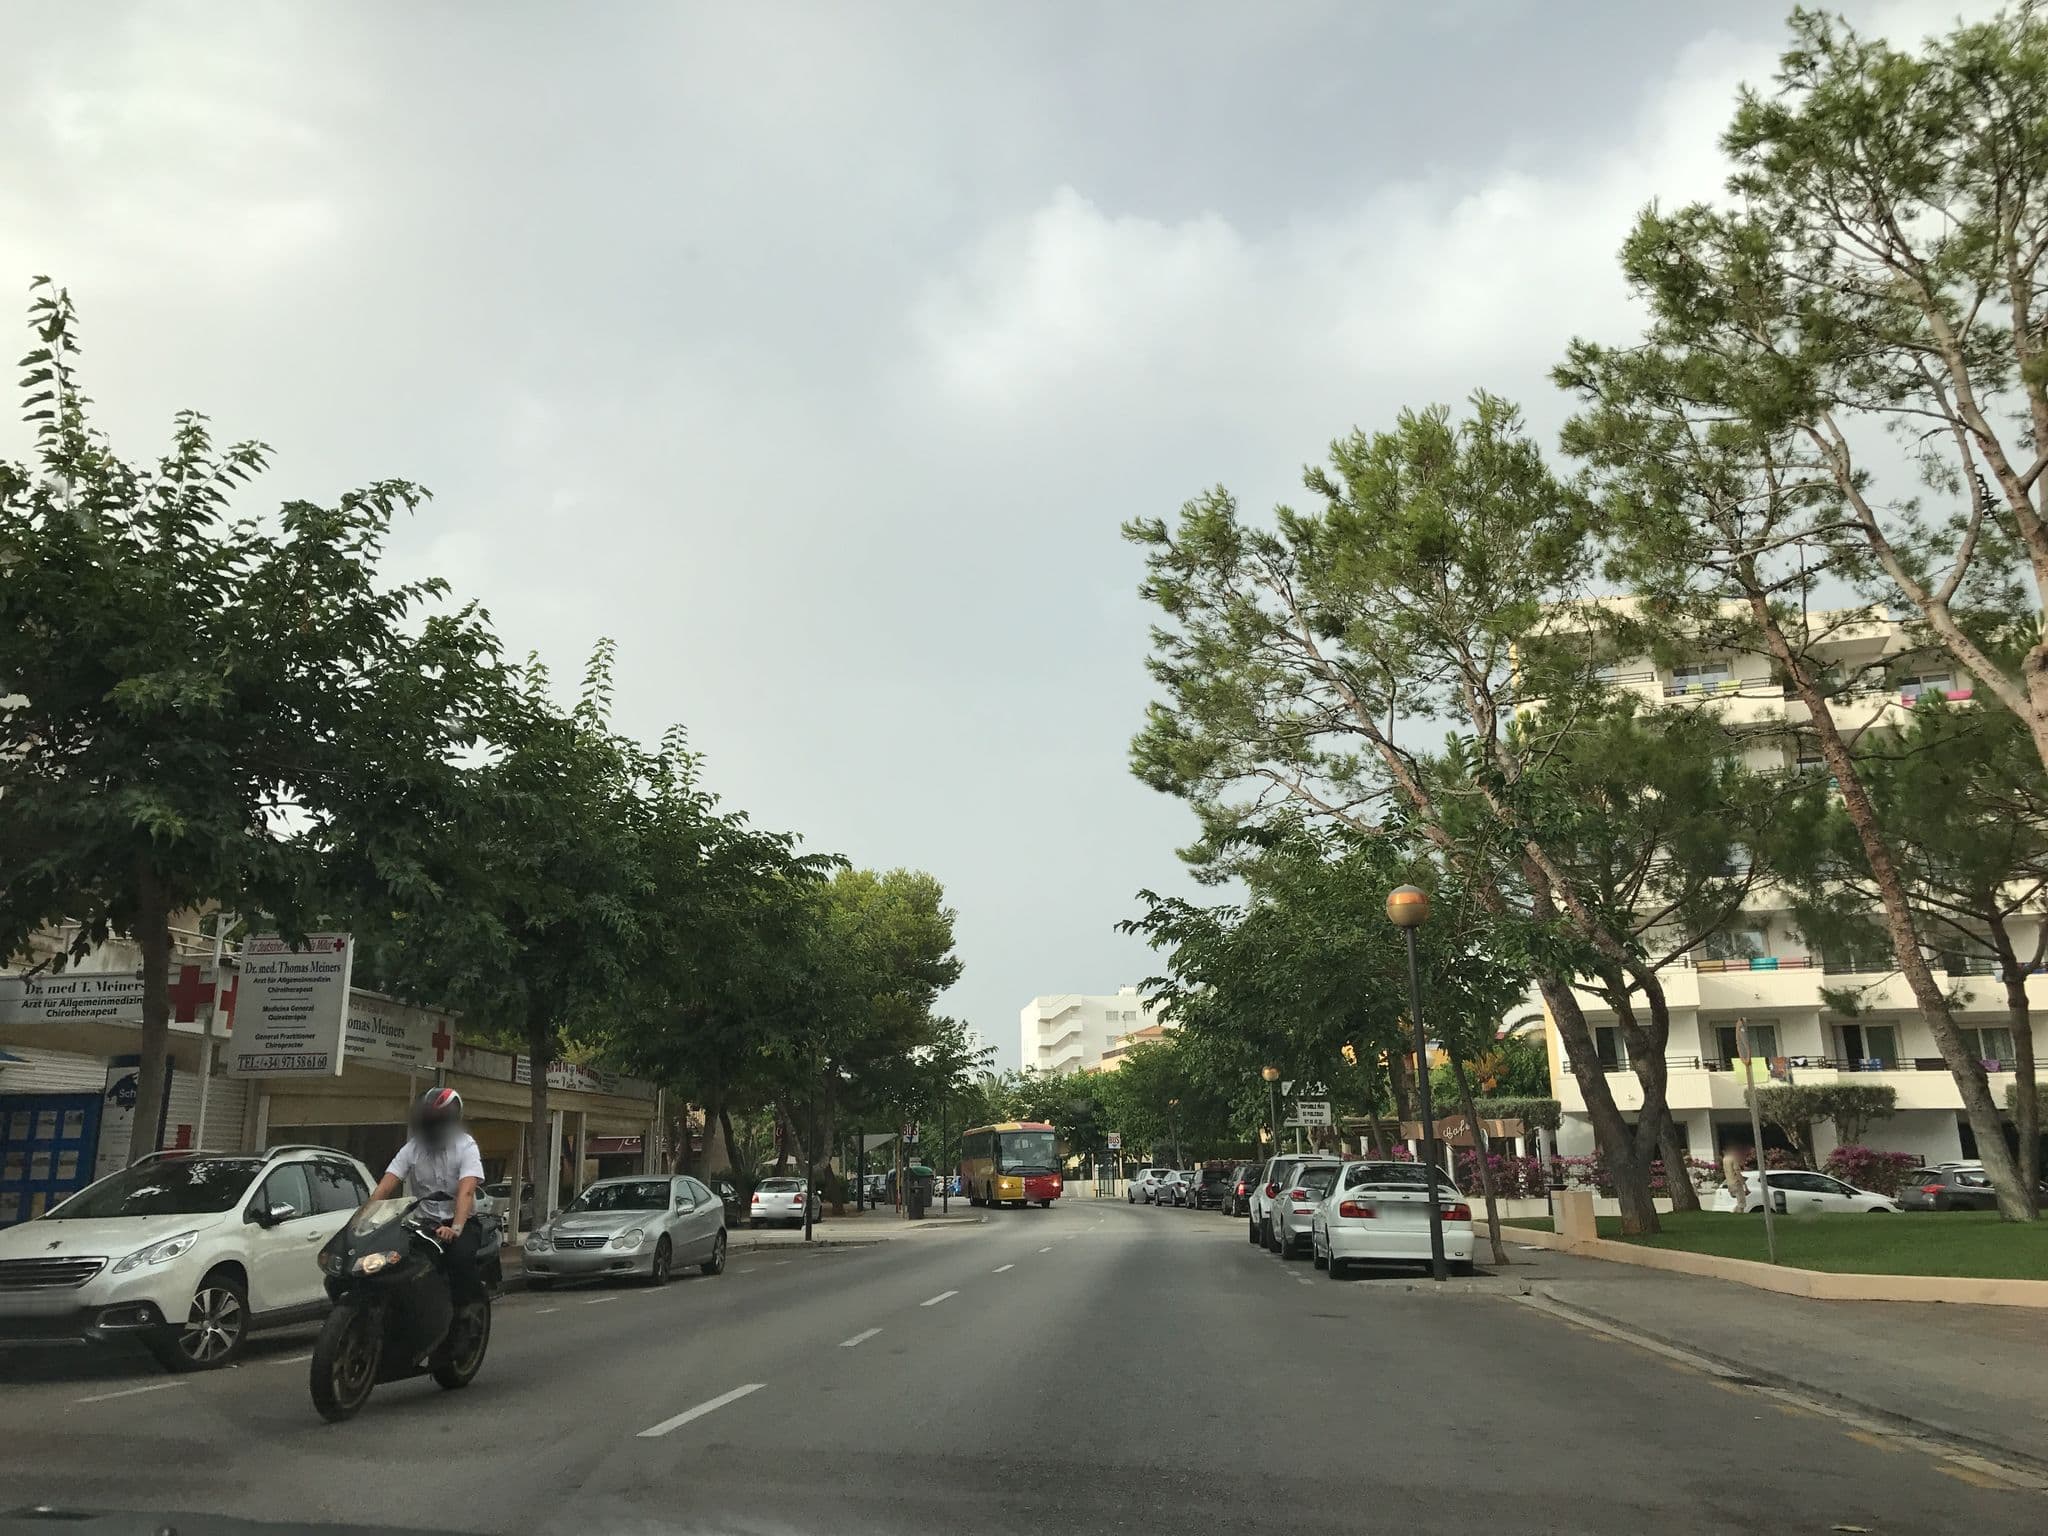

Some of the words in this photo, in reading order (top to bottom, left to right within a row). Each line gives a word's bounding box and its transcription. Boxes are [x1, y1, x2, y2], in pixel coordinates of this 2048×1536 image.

[245, 962, 257, 974] Dr.
[258, 962, 277, 973] med.
[279, 961, 308, 974] Thomas
[309, 960, 341, 973] Meiners
[277, 976, 331, 985] Allgemeinmedizin
[25, 984, 44, 995] Dr.
[48, 982, 76, 994] med
[82, 981, 91, 992] T.
[97, 980, 145, 992] Meiners
[267, 986, 312, 994] Chirotherapeut
[21, 1000, 41, 1009] Arzt
[59, 997, 143, 1010] Allgemeinmedizin
[290, 1004, 315, 1012] General
[46, 1008, 117, 1018] Chirotherapeut
[347, 1017, 371, 1031] omas
[371, 1016, 405, 1038] Meiners
[281, 1056, 295, 1068] 971
[307, 1055, 316, 1067] 61
[317, 1055, 327, 1067] 60
[1108, 1136, 1120, 1144] BUS
